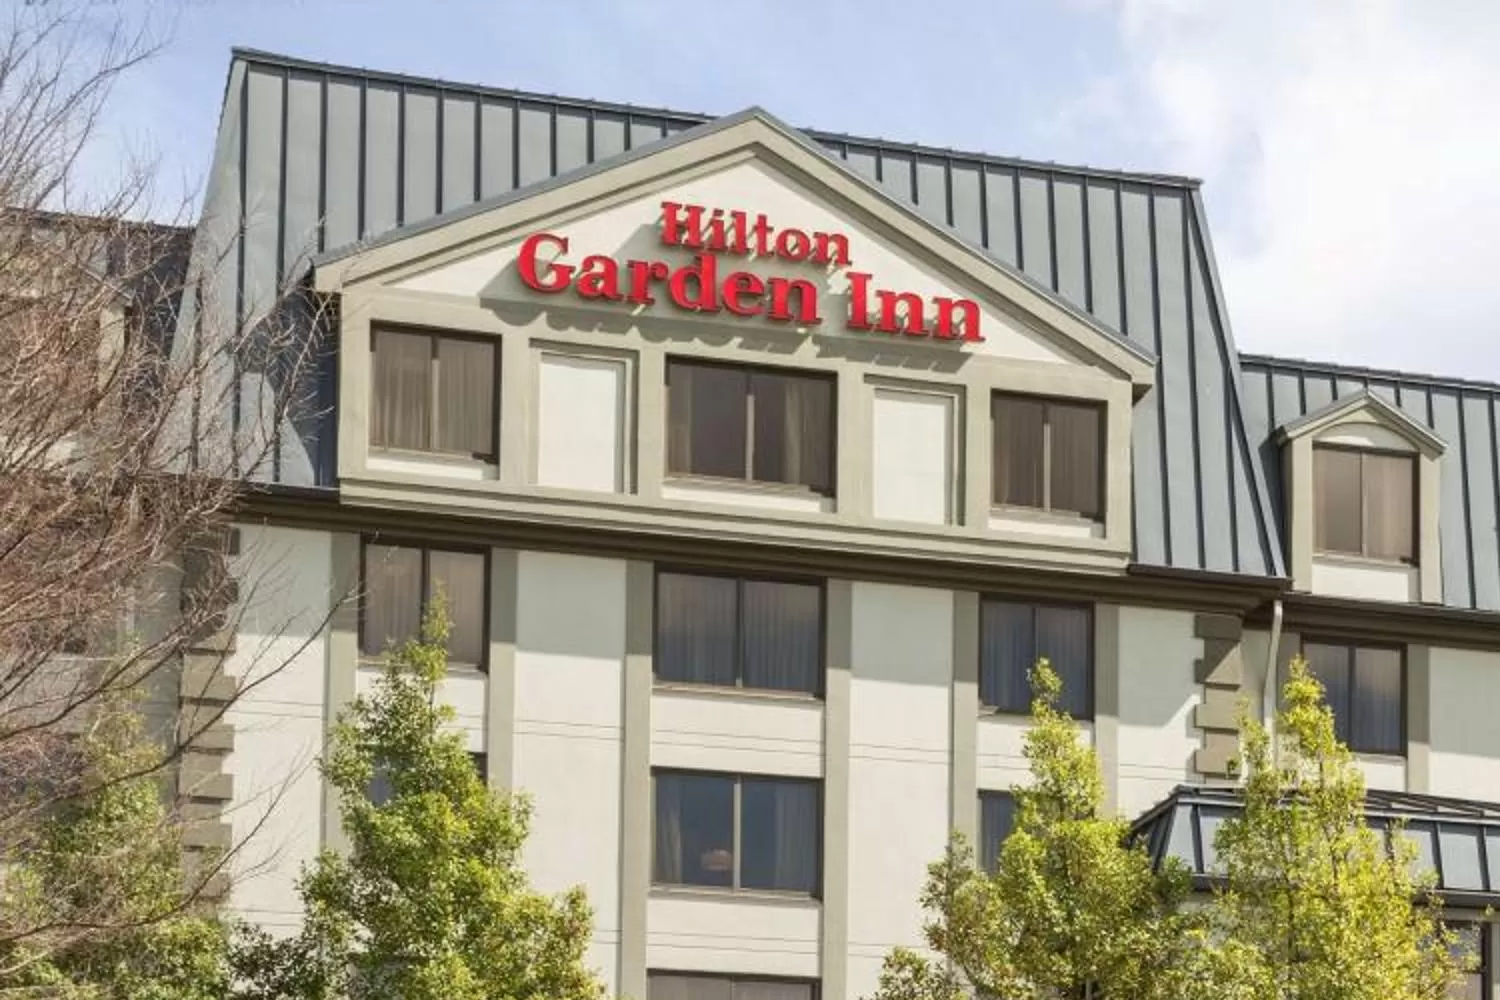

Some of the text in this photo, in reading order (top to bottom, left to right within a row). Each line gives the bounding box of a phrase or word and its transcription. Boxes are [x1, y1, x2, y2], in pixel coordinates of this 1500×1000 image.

[661, 201, 852, 266] Hilton
[516, 232, 986, 342] Garden Inn
